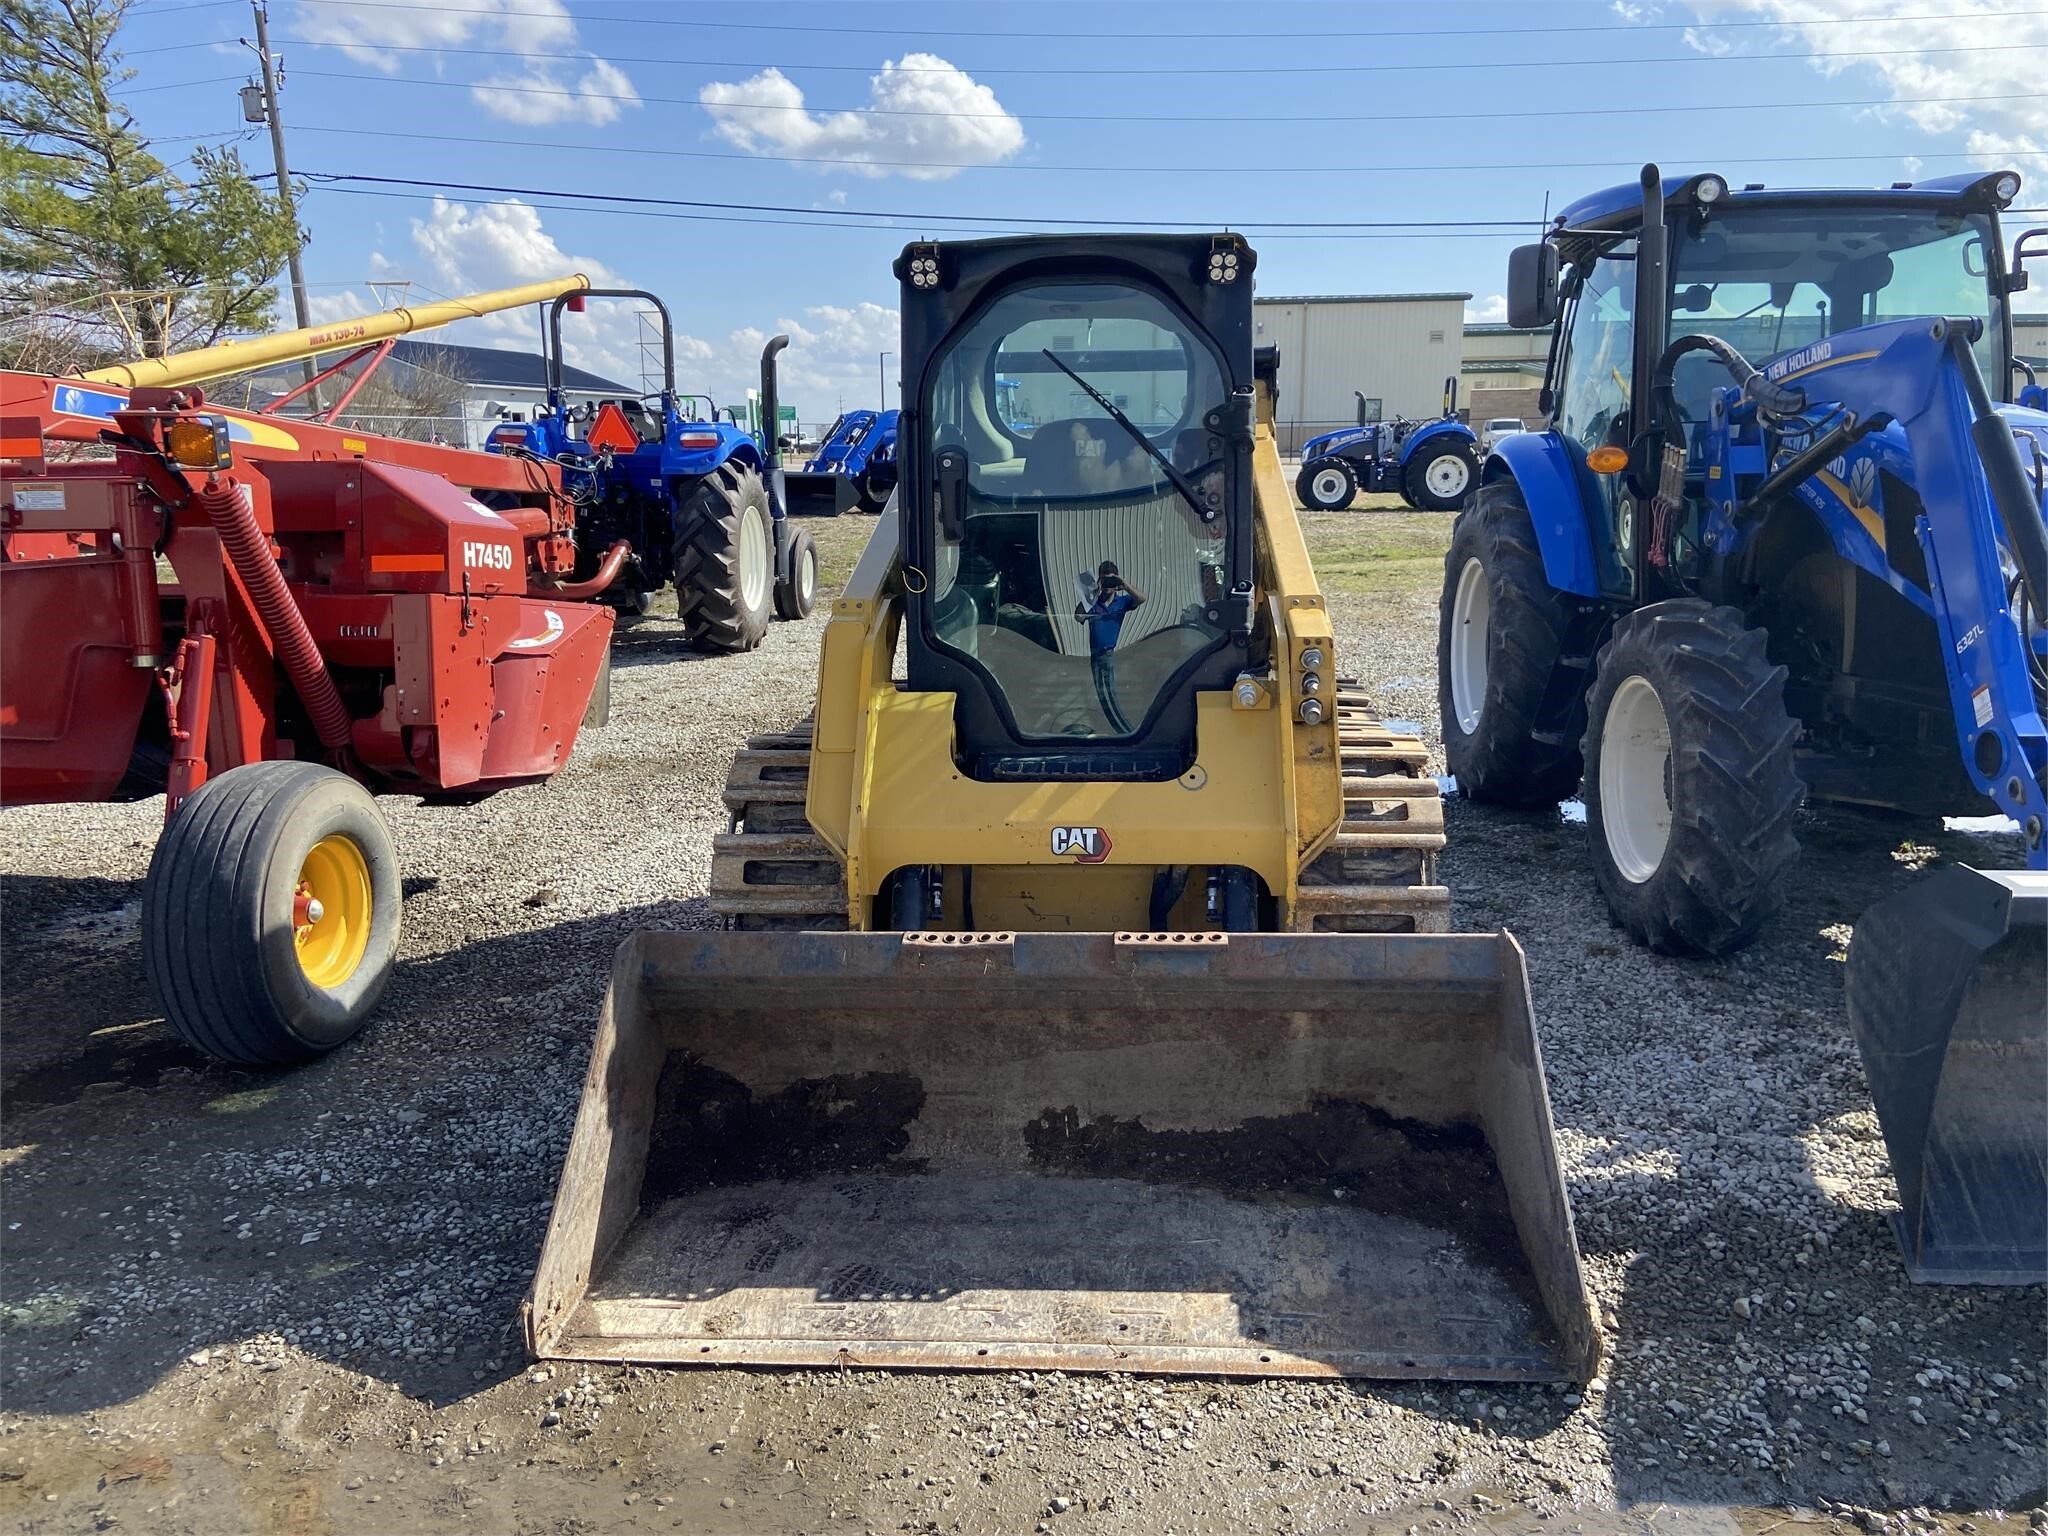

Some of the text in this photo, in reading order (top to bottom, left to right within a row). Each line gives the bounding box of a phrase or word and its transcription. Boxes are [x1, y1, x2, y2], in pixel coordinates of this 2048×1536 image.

[1767, 342, 1832, 382] NEW HOLLAND
[1074, 439, 1106, 457] CAT
[463, 541, 513, 570] H7450
[1956, 624, 1984, 654] 632TL
[1052, 827, 1098, 855] CAT
